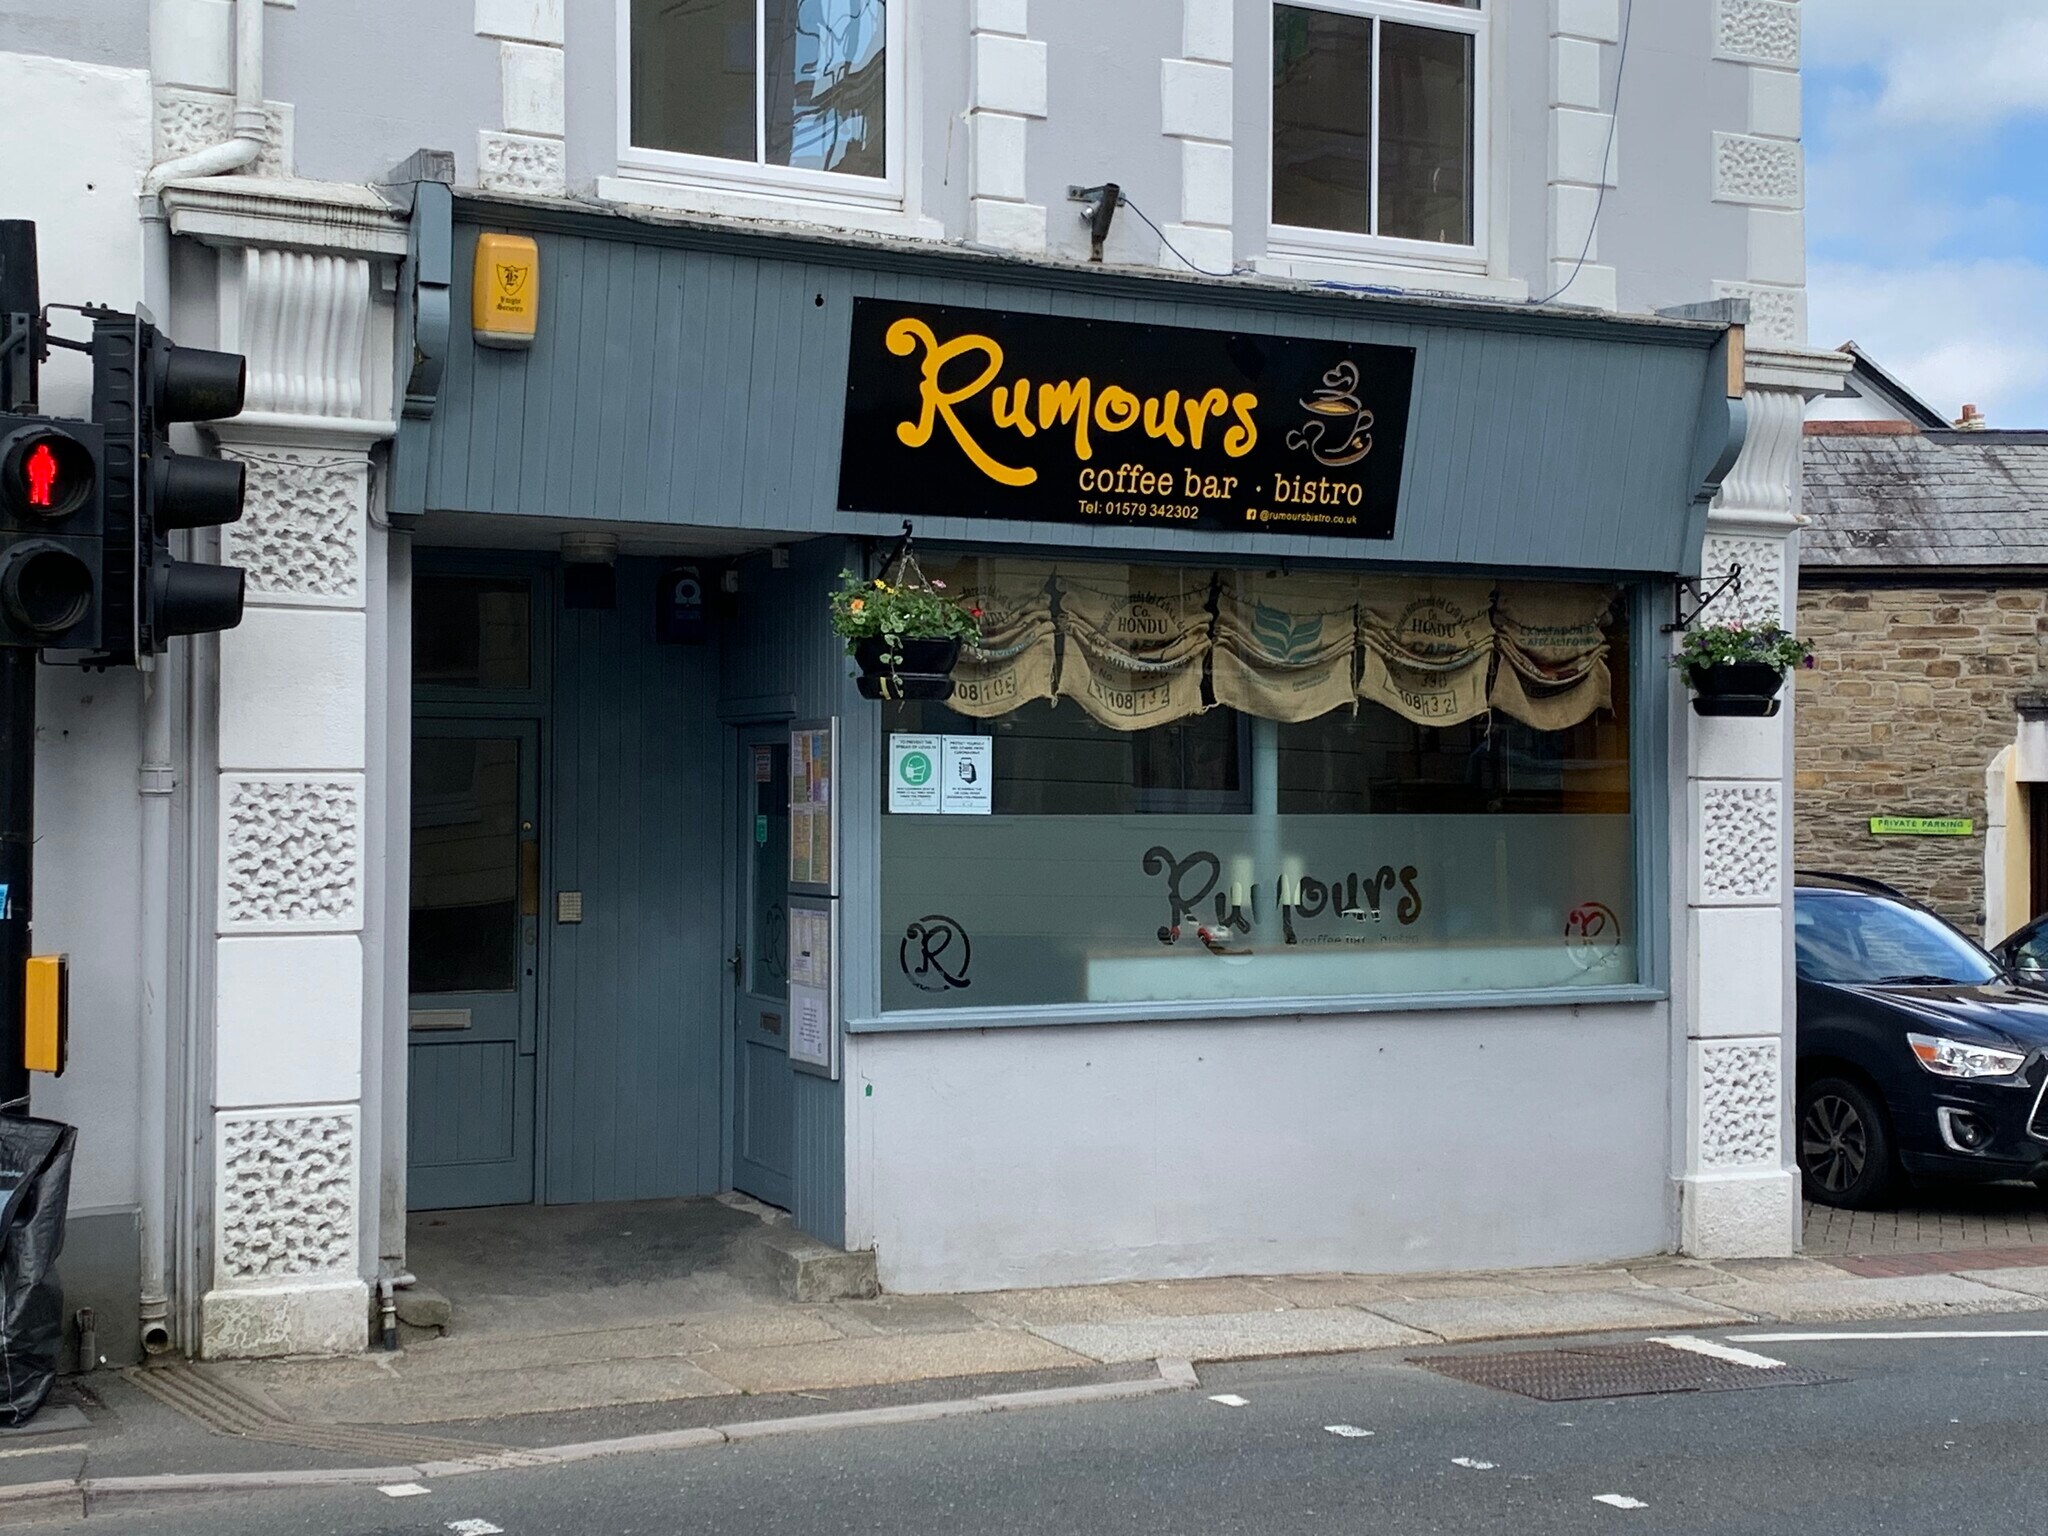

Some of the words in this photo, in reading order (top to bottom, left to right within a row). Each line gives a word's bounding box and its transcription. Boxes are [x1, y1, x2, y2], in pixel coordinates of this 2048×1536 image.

[885, 317, 1259, 487] Rumours
[1079, 464, 1174, 496] coffee
[1184, 467, 1239, 499] bar
[1274, 473, 1363, 507] bistro
[1078, 500, 1103, 515] Tel:
[1105, 501, 1147, 517] 01579
[1149, 504, 1199, 520] 342302
[1259, 510, 1357, 524] @rumoursbistro.co.uk
[1117, 616, 1169, 635] HONDU
[1107, 690, 1134, 711] 108
[1878, 819, 1917, 827] PRIVATE
[1922, 820, 1964, 828] PARKING
